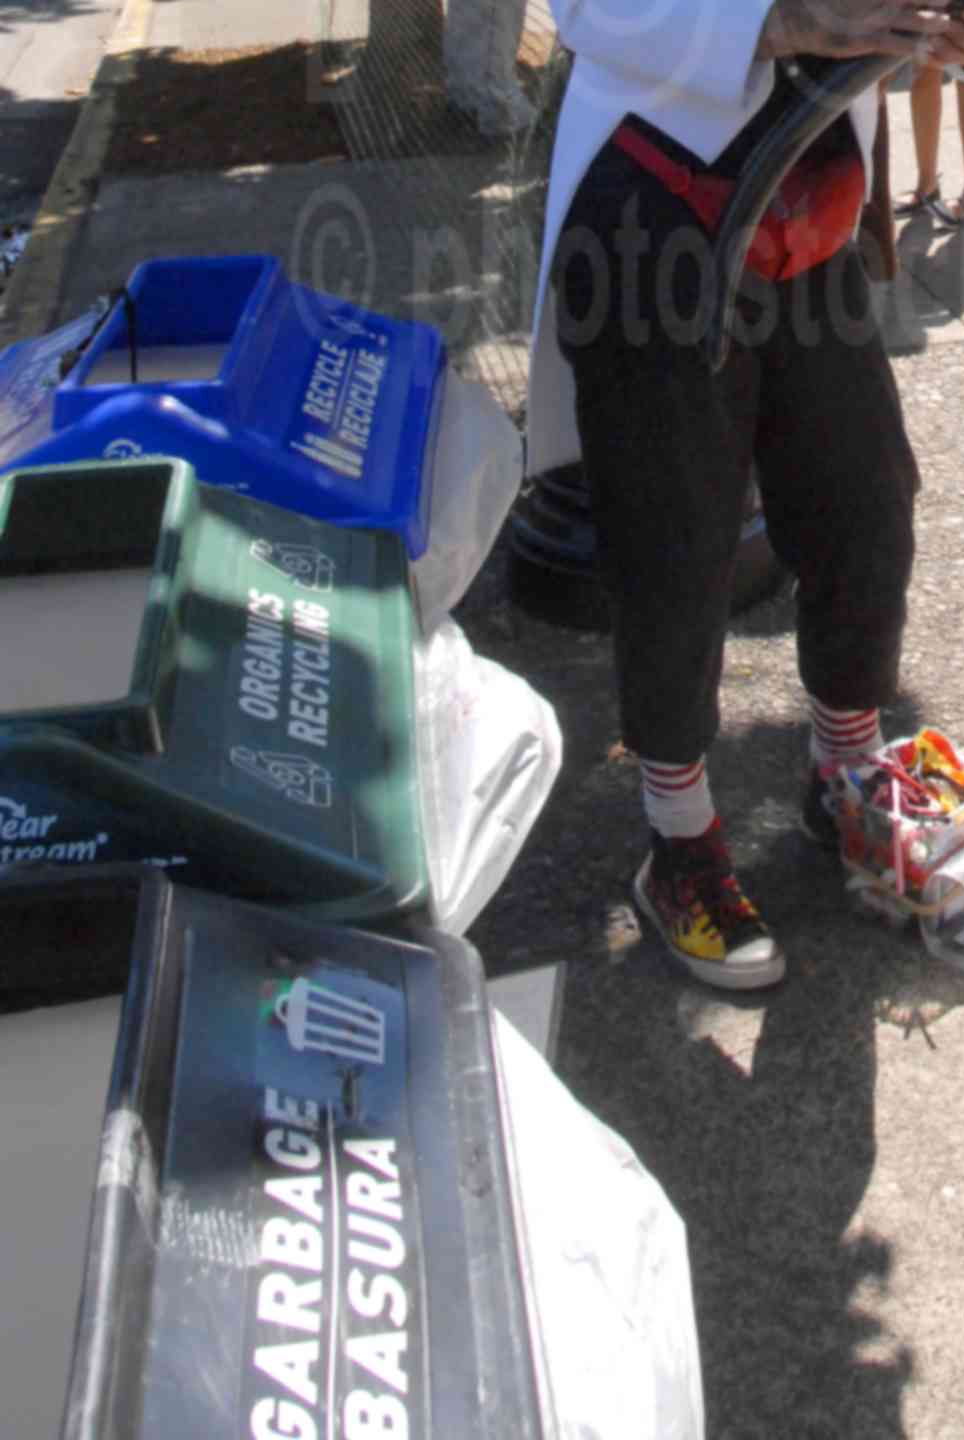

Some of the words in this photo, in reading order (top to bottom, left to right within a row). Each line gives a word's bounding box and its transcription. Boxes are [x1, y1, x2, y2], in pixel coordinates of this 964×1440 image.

[302, 339, 348, 424] RECYCLE
[338, 348, 387, 449] RECICLAJE
[237, 587, 285, 721] ORGANICS
[288, 599, 331, 747] RECYCLING
[251, 1087, 324, 1440] GARBAGE
[342, 1139, 409, 1440] BASURA
